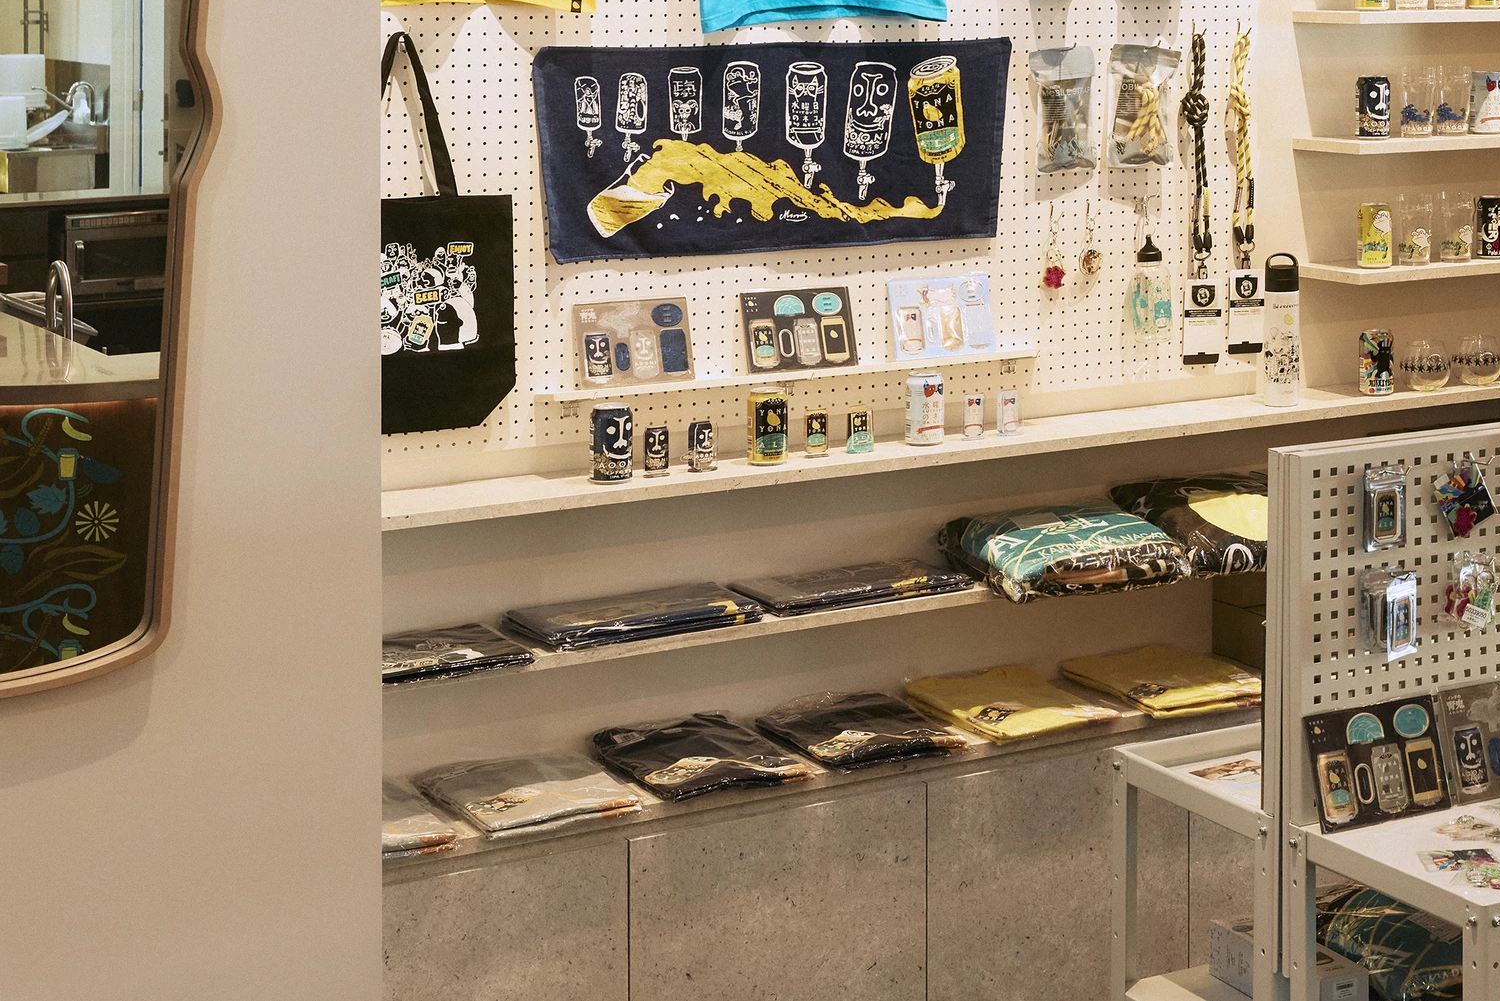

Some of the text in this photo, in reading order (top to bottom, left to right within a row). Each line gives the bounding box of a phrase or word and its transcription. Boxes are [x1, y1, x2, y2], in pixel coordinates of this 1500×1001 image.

[913, 93, 953, 109] YONA
[916, 114, 955, 129] YONA
[415, 291, 439, 304] BEER
[759, 407, 787, 416] YONA
[759, 424, 787, 433] YONA
